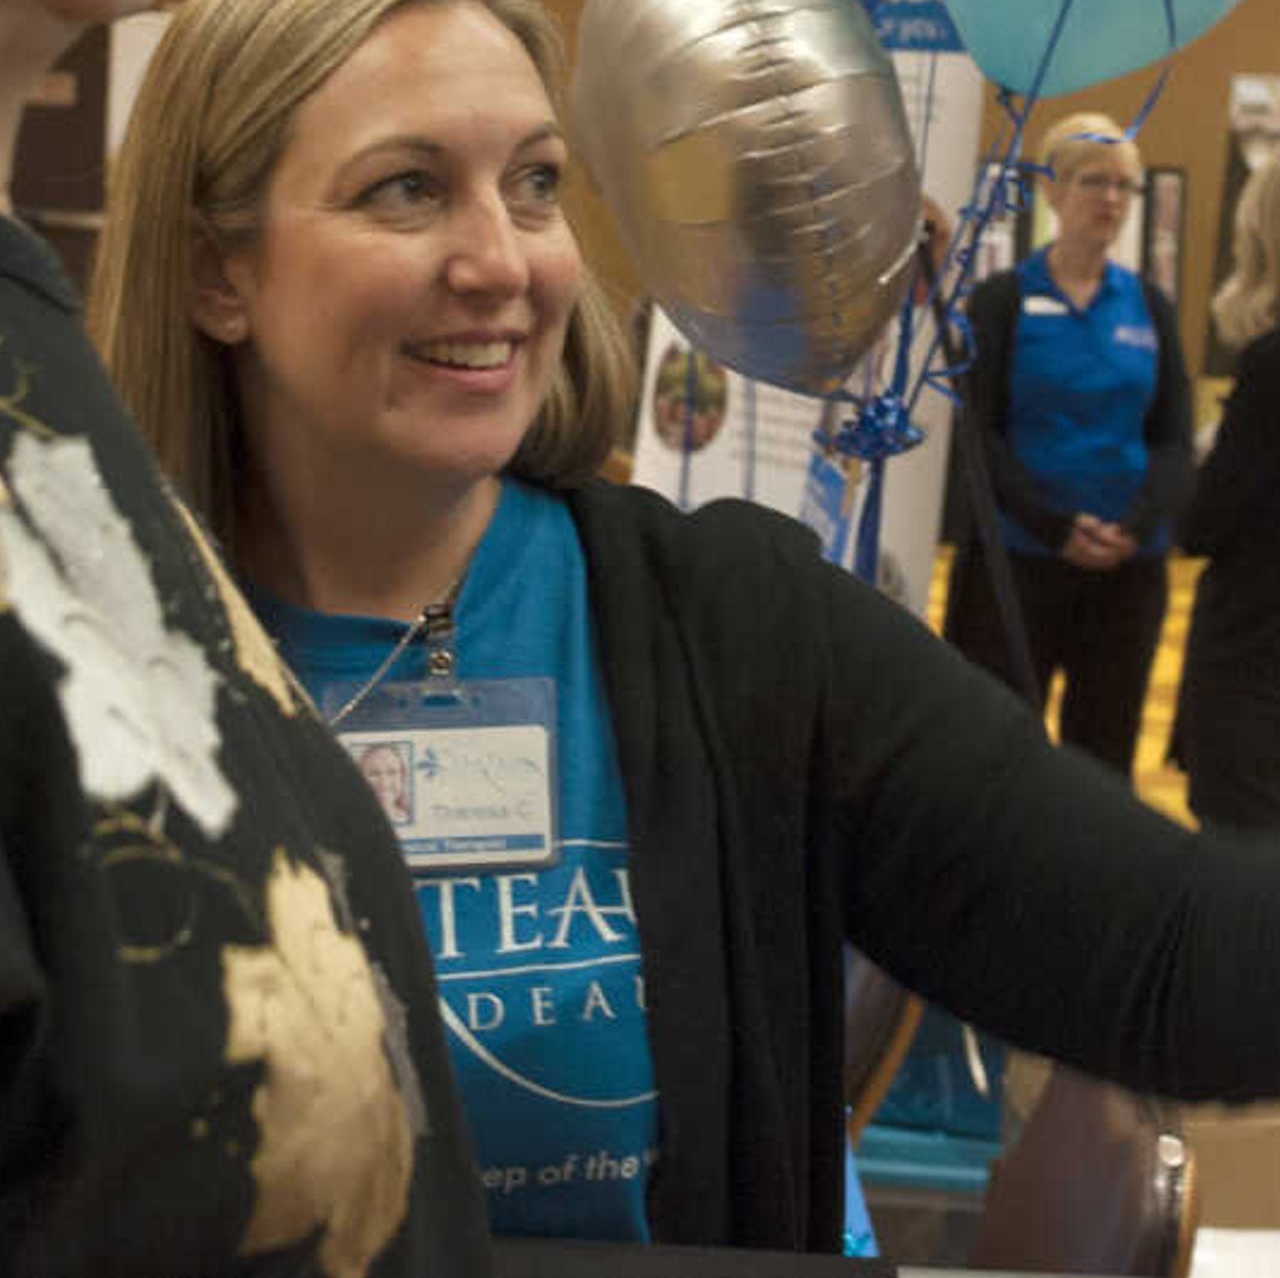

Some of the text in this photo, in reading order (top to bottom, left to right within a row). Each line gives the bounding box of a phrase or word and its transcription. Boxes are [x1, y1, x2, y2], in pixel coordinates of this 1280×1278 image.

[466, 974, 647, 1031] DEA
[539, 1153, 579, 1185] of
[585, 1150, 640, 1181] the
